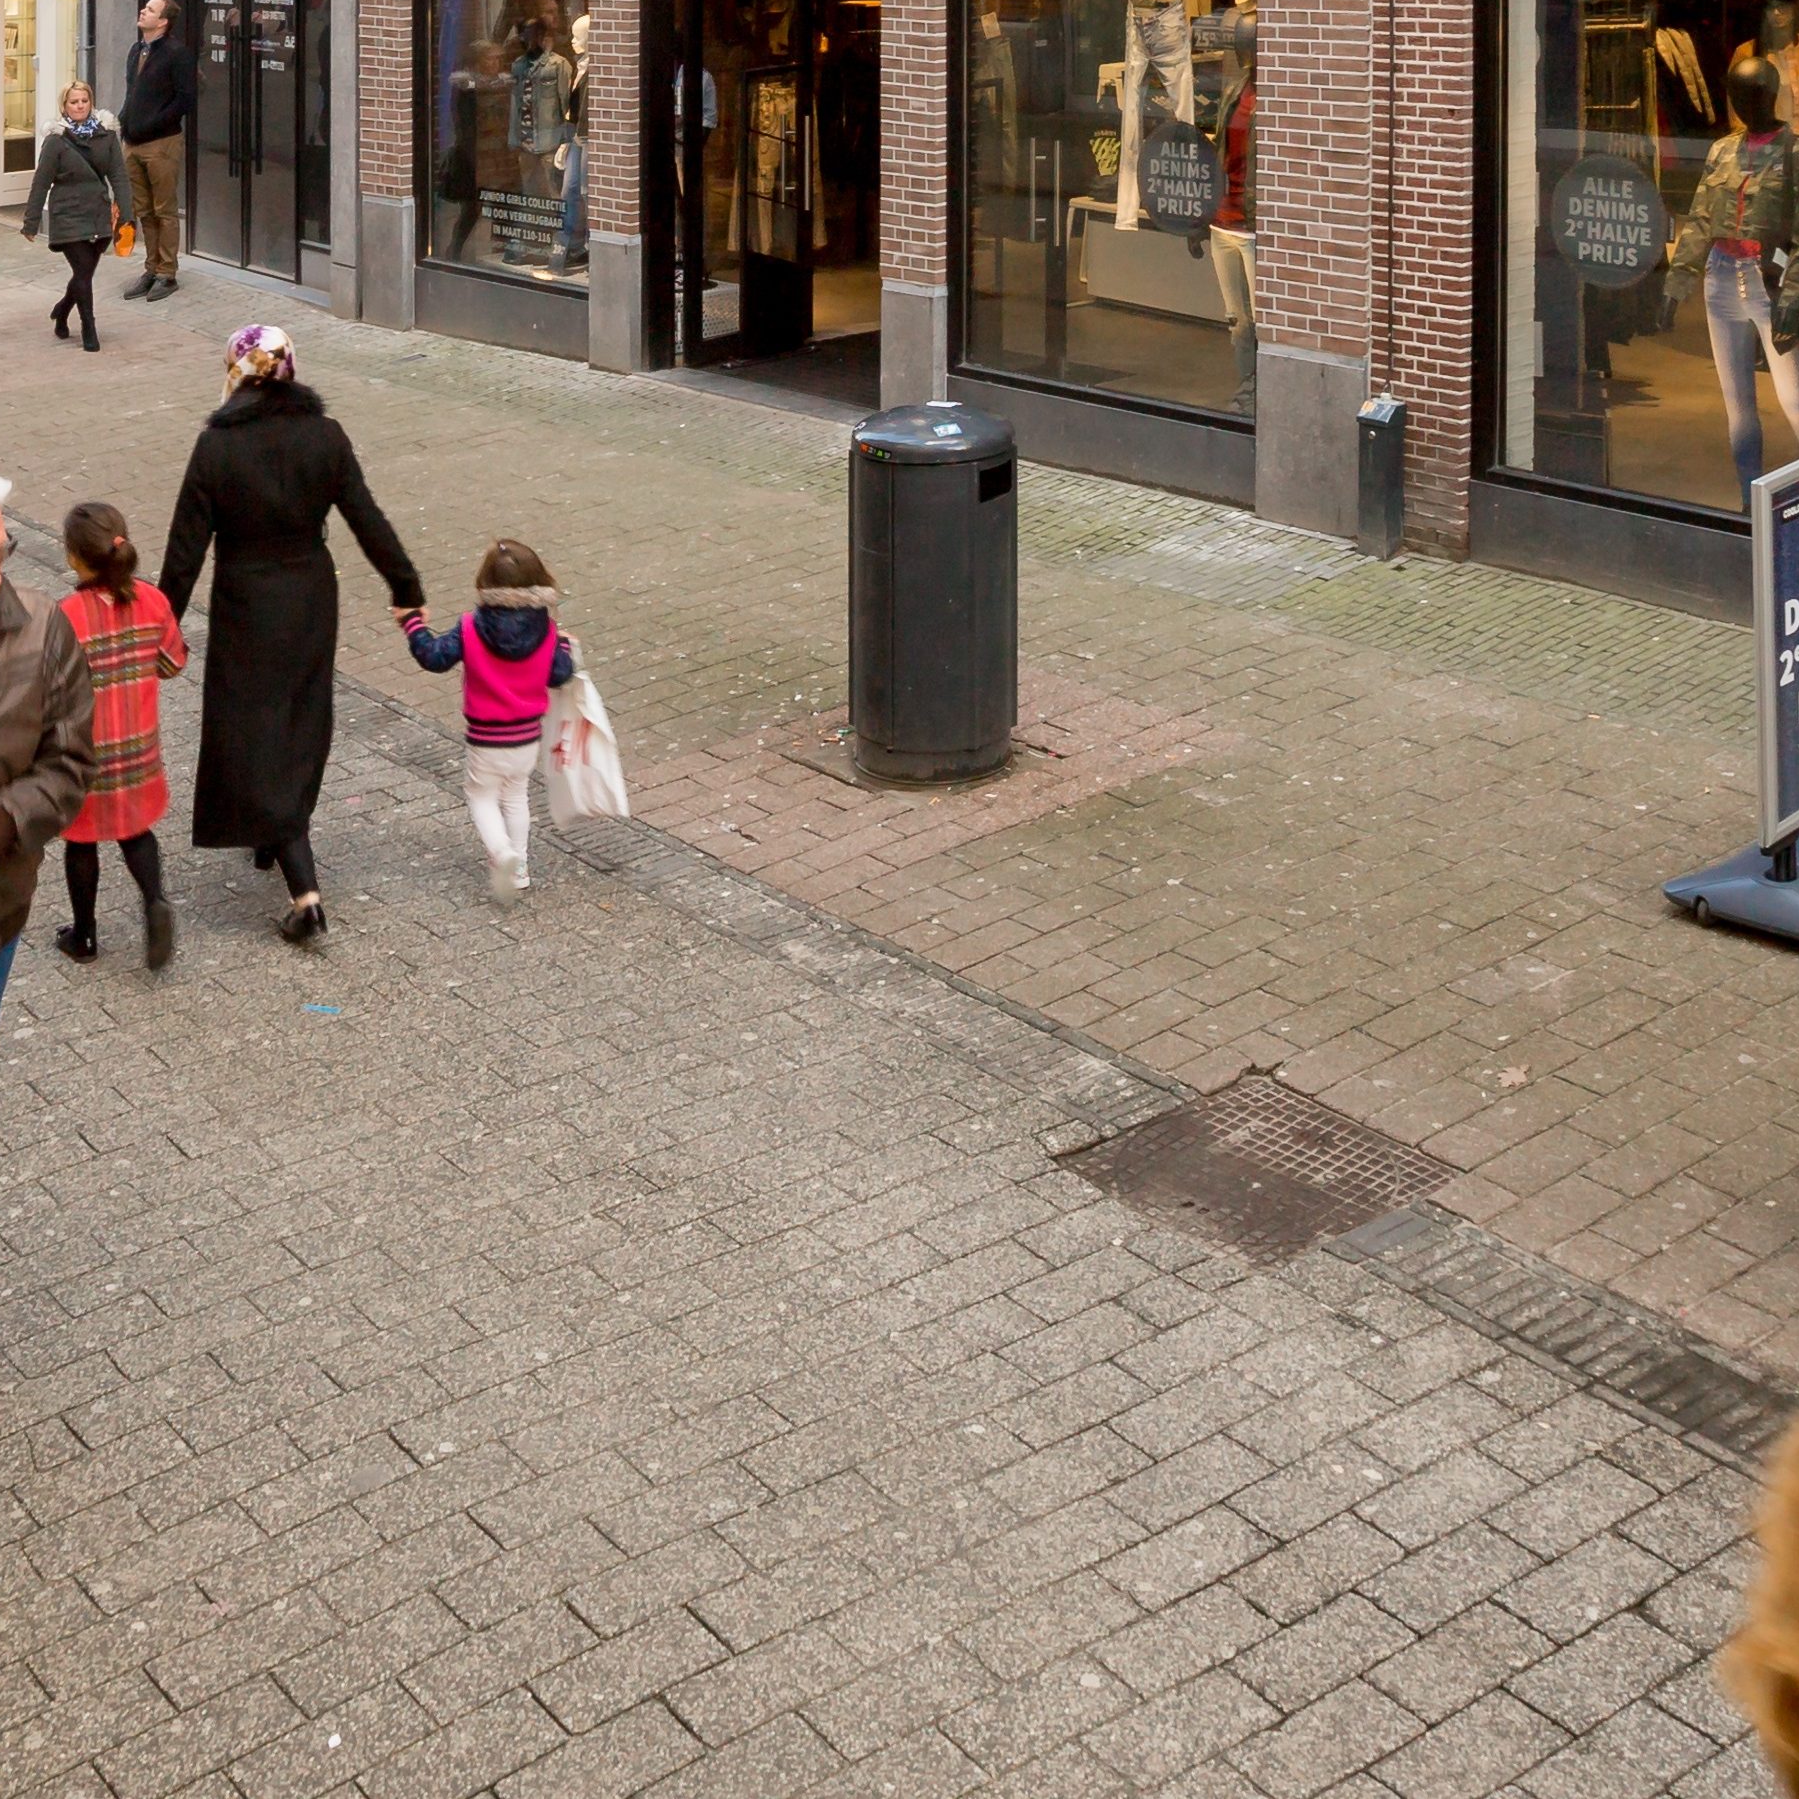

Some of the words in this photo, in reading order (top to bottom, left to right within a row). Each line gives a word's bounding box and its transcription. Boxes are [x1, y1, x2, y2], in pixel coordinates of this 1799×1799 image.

[1161, 141, 1198, 160] ALLE
[1150, 158, 1210, 180] DENIMS
[1164, 179, 1212, 200] HALVE
[1582, 176, 1634, 199] ALLE
[480, 190, 505, 201] JUNIOR
[506, 194, 527, 207] GIRLS
[527, 197, 567, 213] COLLECTIE
[1157, 197, 1203, 218] PRIJS
[1568, 196, 1649, 224] DENIMS
[493, 208, 509, 220] OOK
[509, 210, 563, 229] VERKRIJGBAAR
[502, 225, 521, 238] MAAT
[1587, 220, 1652, 246] HALVE
[1578, 241, 1638, 267] PRIJS
